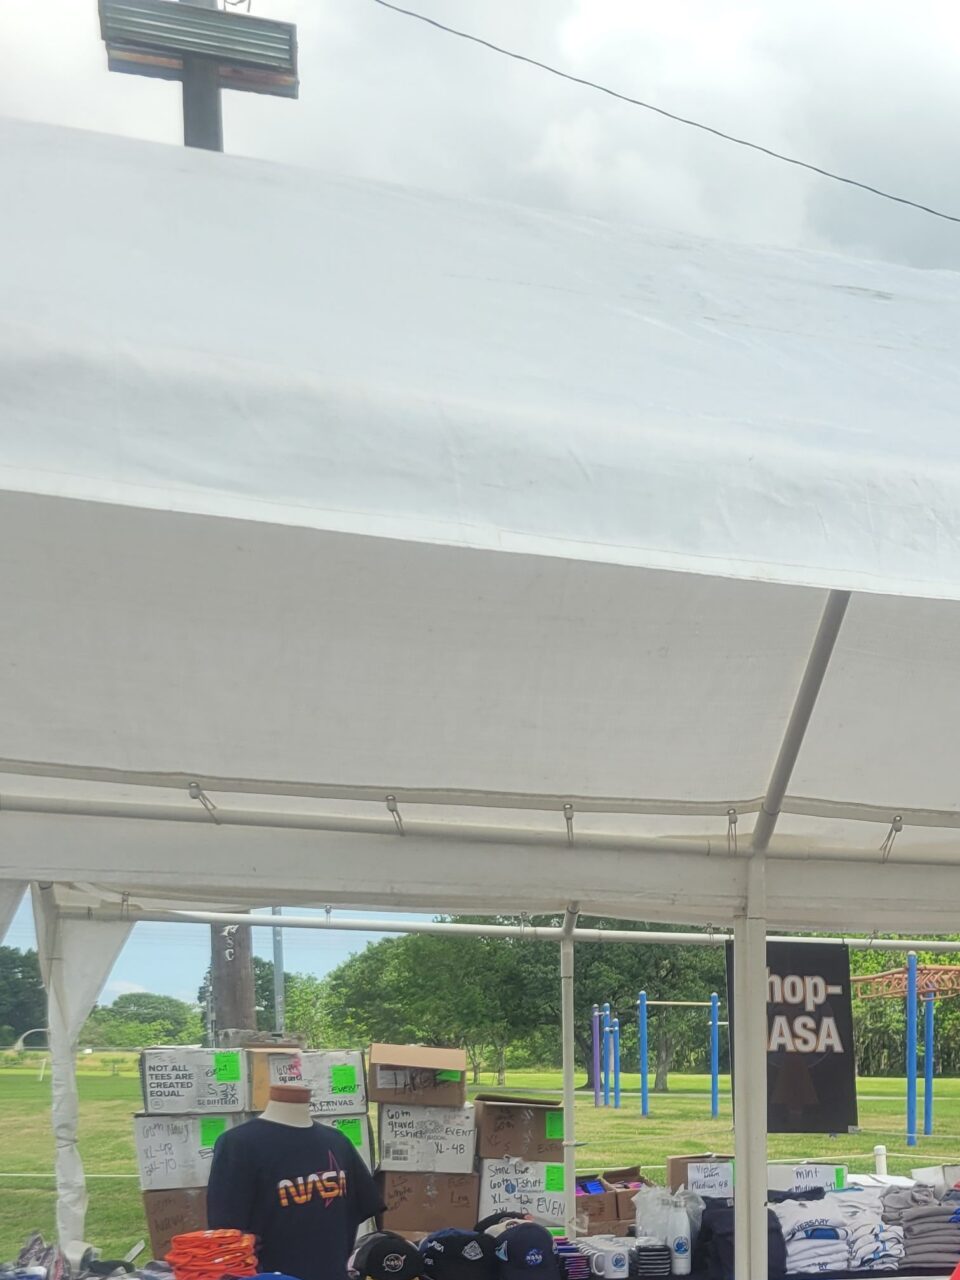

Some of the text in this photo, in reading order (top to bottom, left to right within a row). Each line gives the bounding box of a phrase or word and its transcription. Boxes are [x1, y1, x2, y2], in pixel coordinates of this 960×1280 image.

[767, 967, 843, 1012] hop-
[767, 1015, 845, 1053] ASA
[277, 1169, 347, 1208] NASA
[536, 1197, 566, 1216] EVEN
